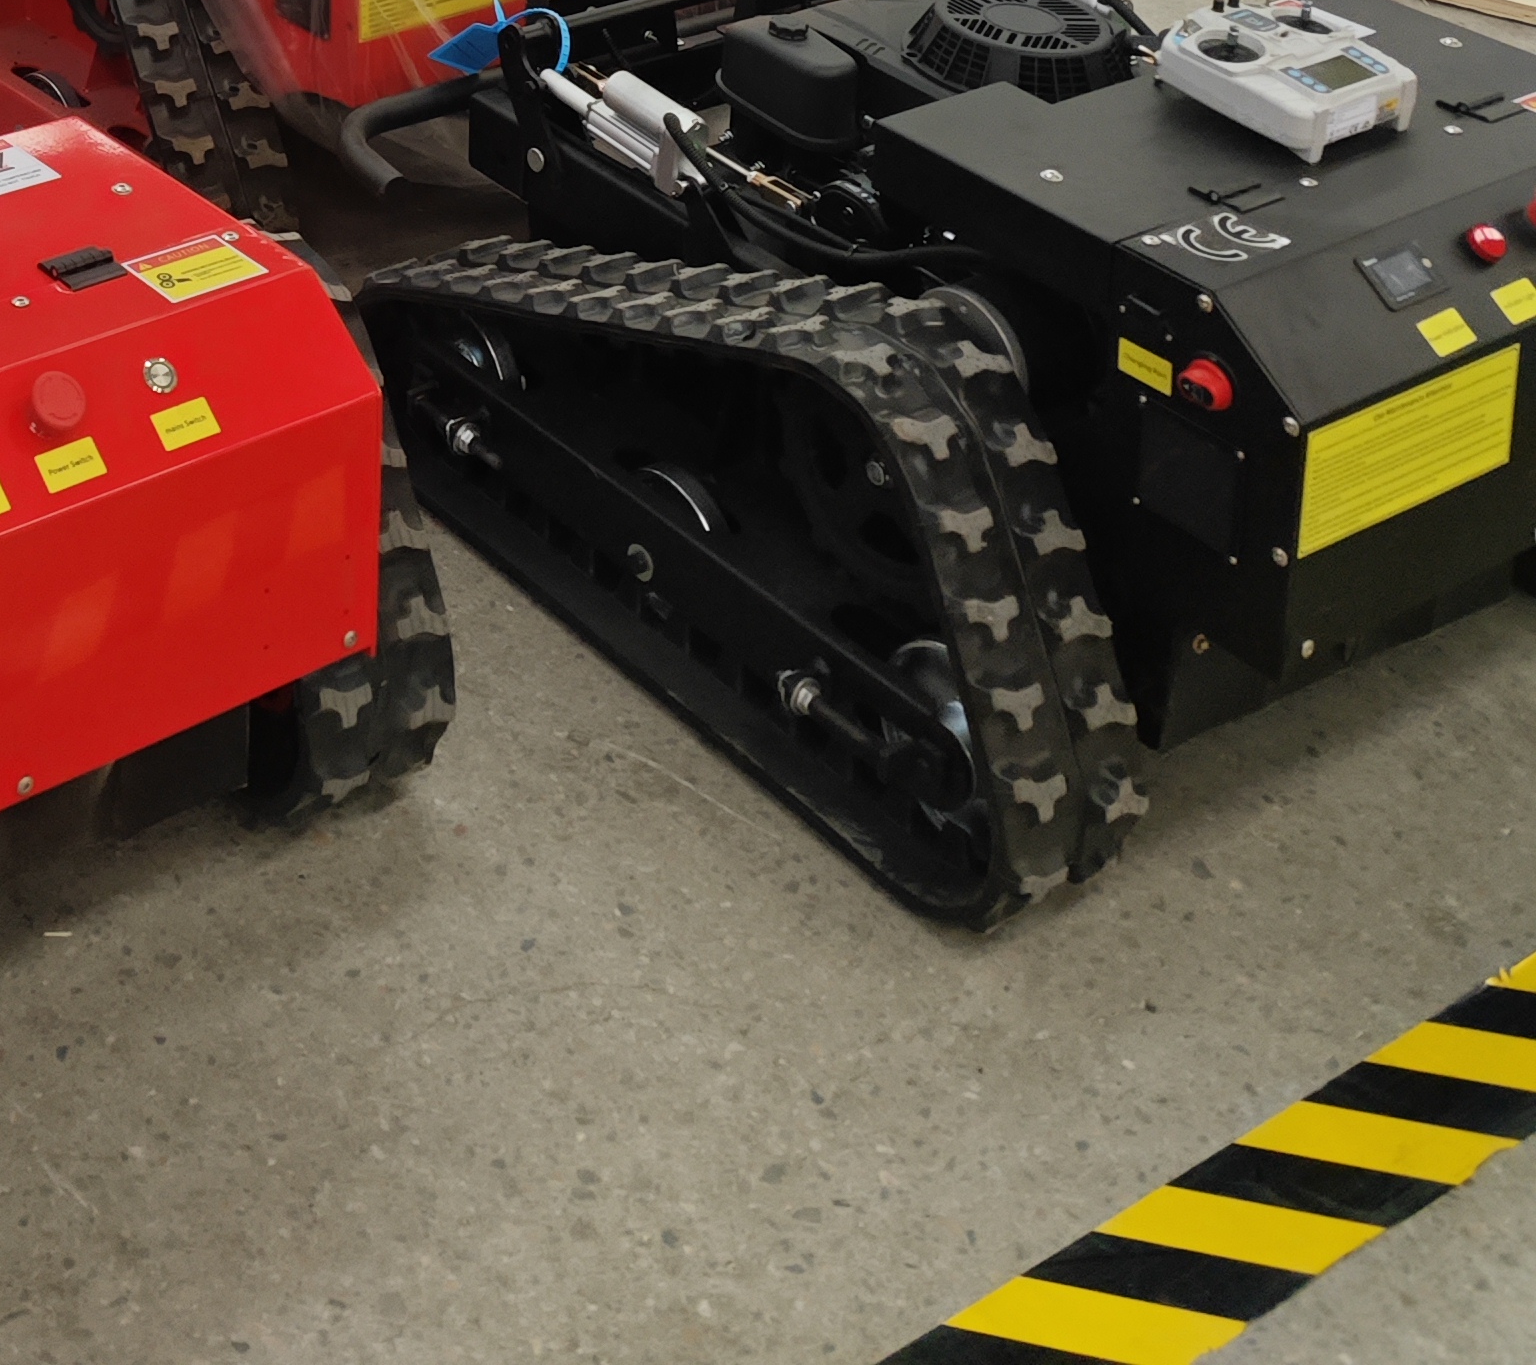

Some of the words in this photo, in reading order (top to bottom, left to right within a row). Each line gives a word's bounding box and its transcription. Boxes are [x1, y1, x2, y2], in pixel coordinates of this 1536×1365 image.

[1176, 212, 1291, 262] CE
[157, 243, 210, 263] CAUTION
[183, 414, 207, 428] Switch
[48, 463, 70, 477] Power
[69, 453, 94, 468] Switch
